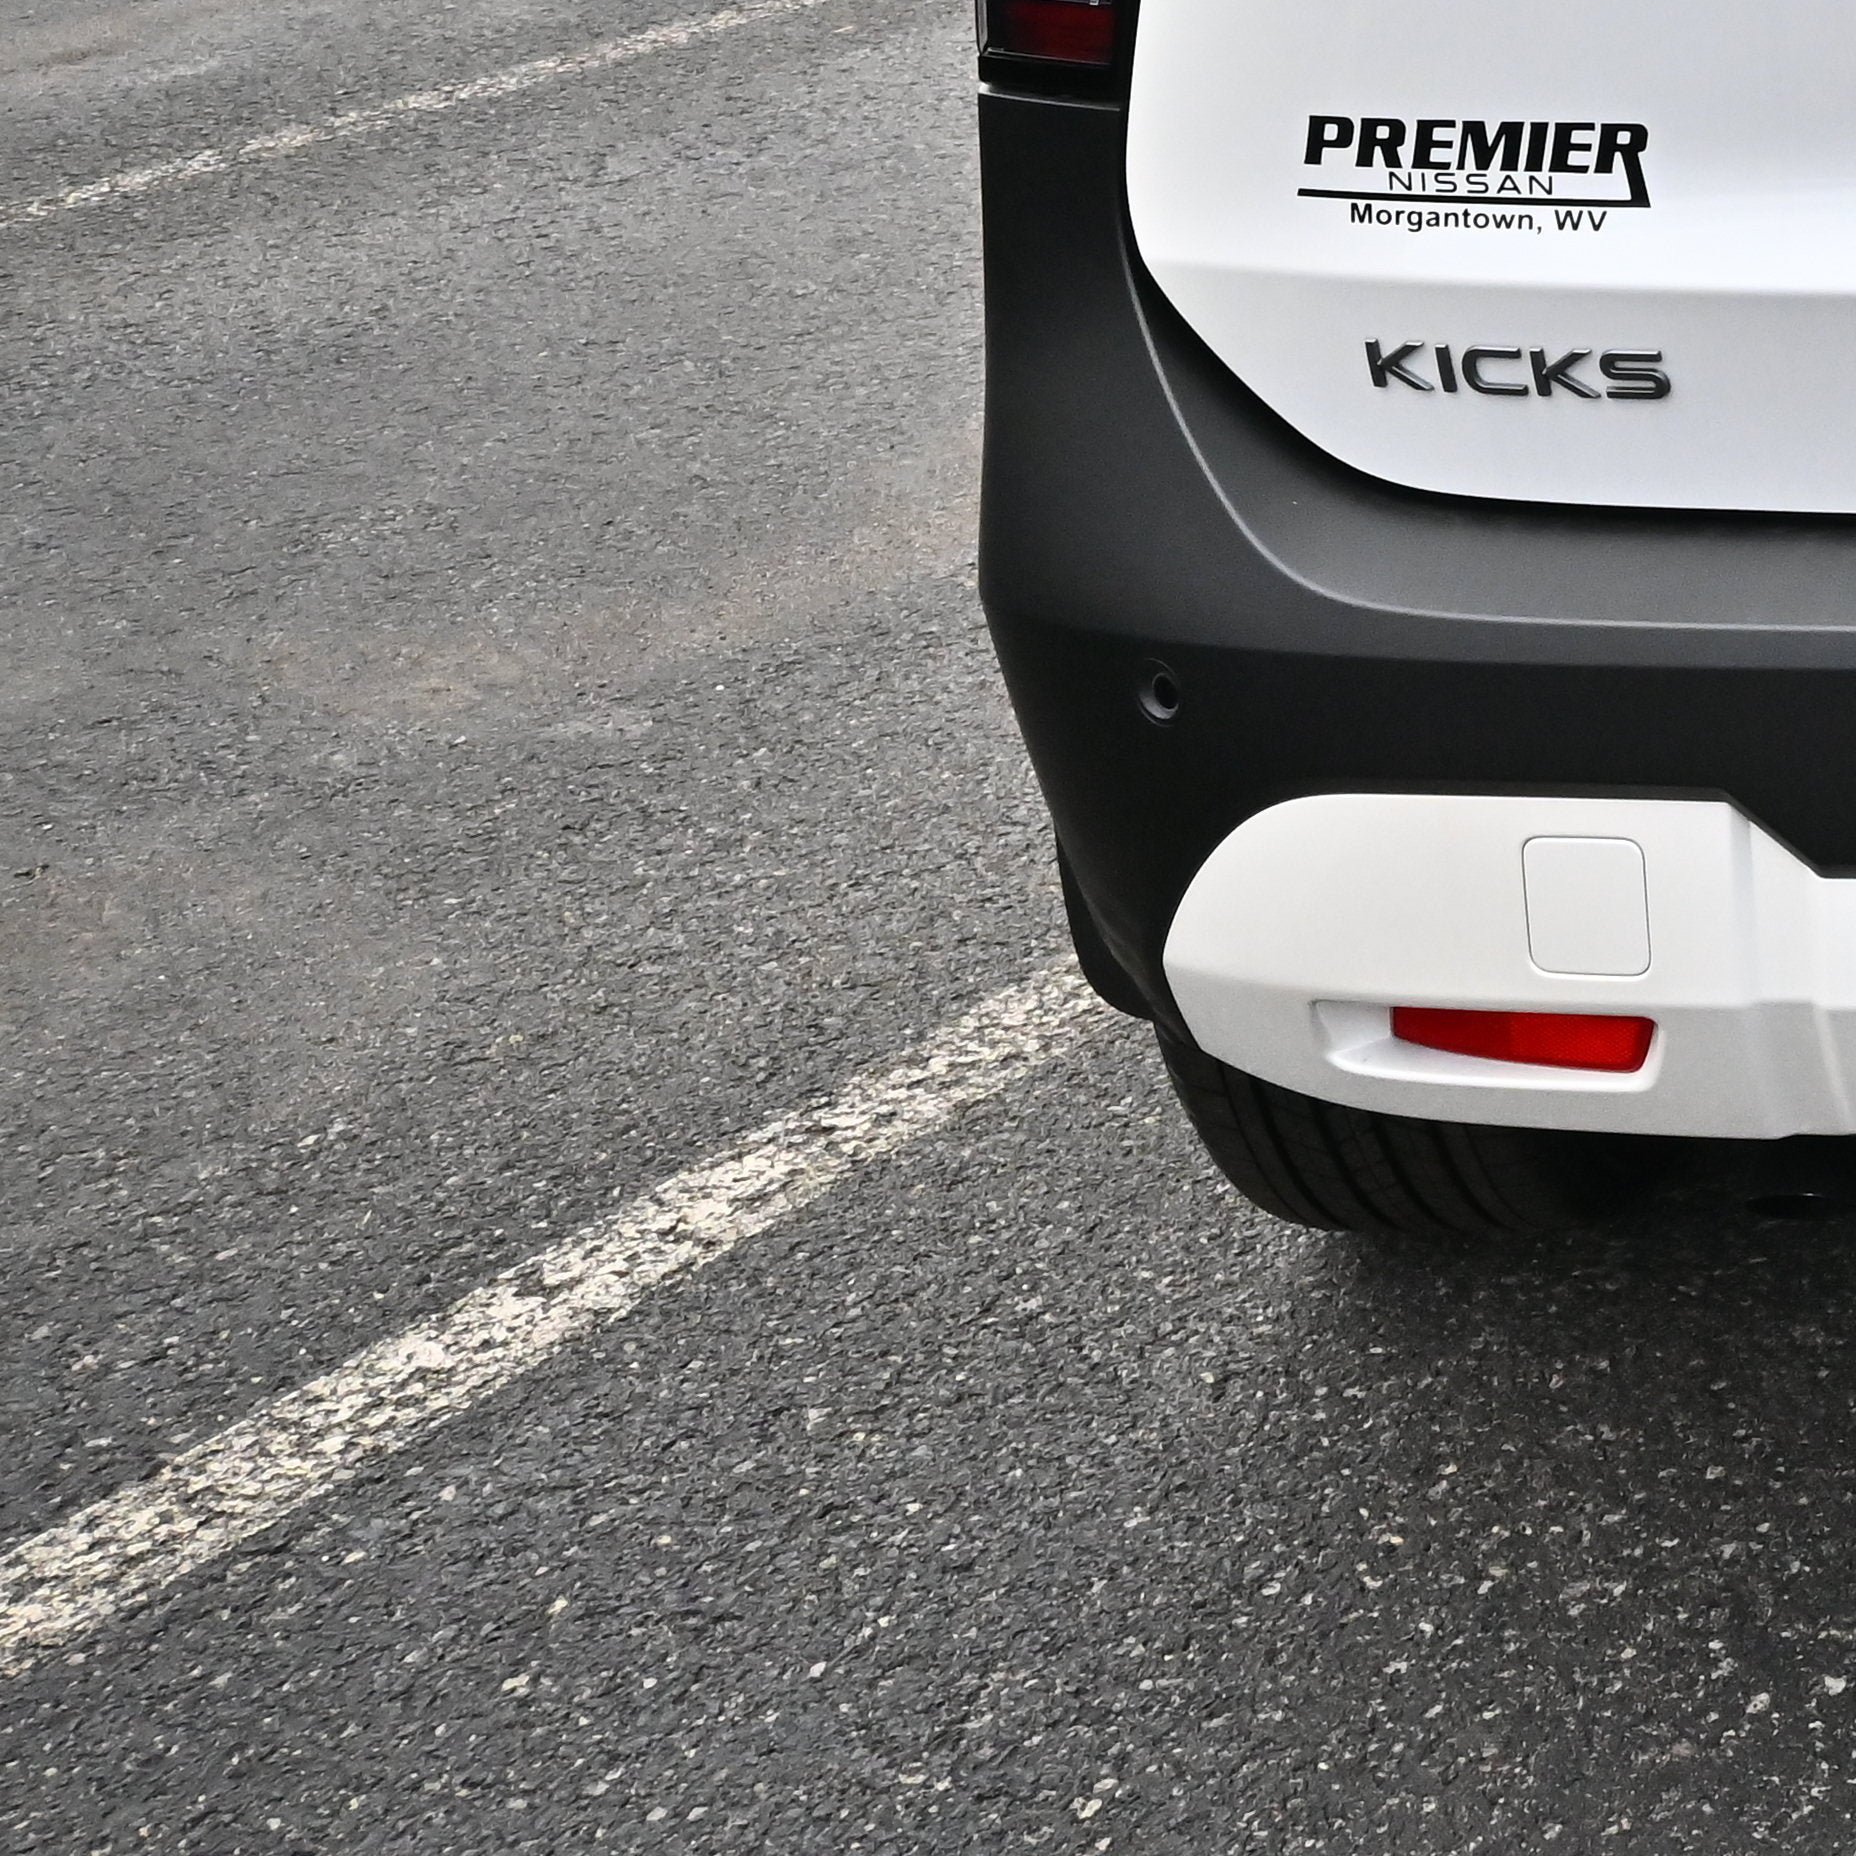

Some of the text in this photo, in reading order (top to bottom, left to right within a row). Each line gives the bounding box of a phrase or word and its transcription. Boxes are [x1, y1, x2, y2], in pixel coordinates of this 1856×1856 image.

[1303, 115, 1651, 194] PREMIER
[1387, 172, 1554, 196] NISSAN
[1350, 202, 1608, 234] Morgantown, WV
[1363, 337, 1672, 400] KICKS
